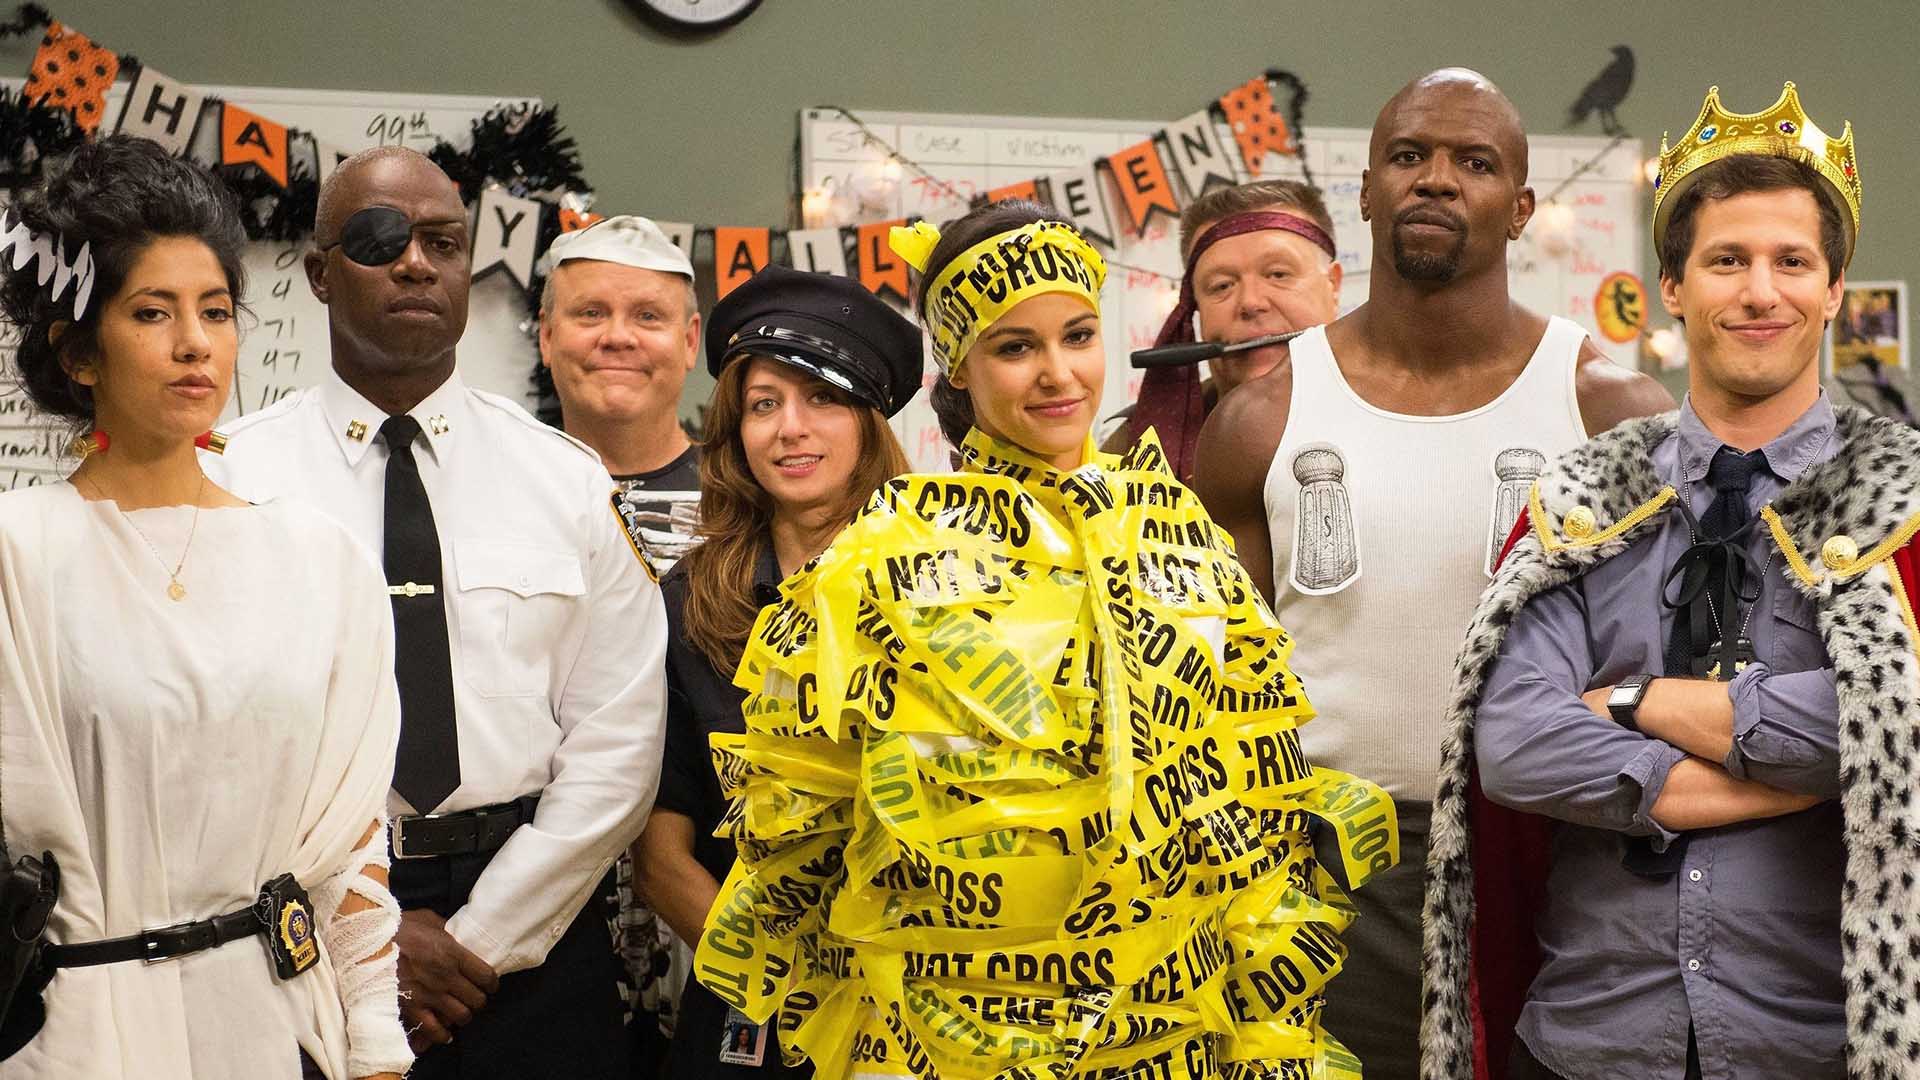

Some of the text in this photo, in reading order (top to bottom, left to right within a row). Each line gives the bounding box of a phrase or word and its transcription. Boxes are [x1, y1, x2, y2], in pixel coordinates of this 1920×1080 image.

[272, 277, 292, 301] 4
[262, 349, 301, 376] 47
[915, 481, 1034, 548] CROSS
[1145, 736, 1228, 830] CROSS
[1248, 954, 1307, 1014] DO
